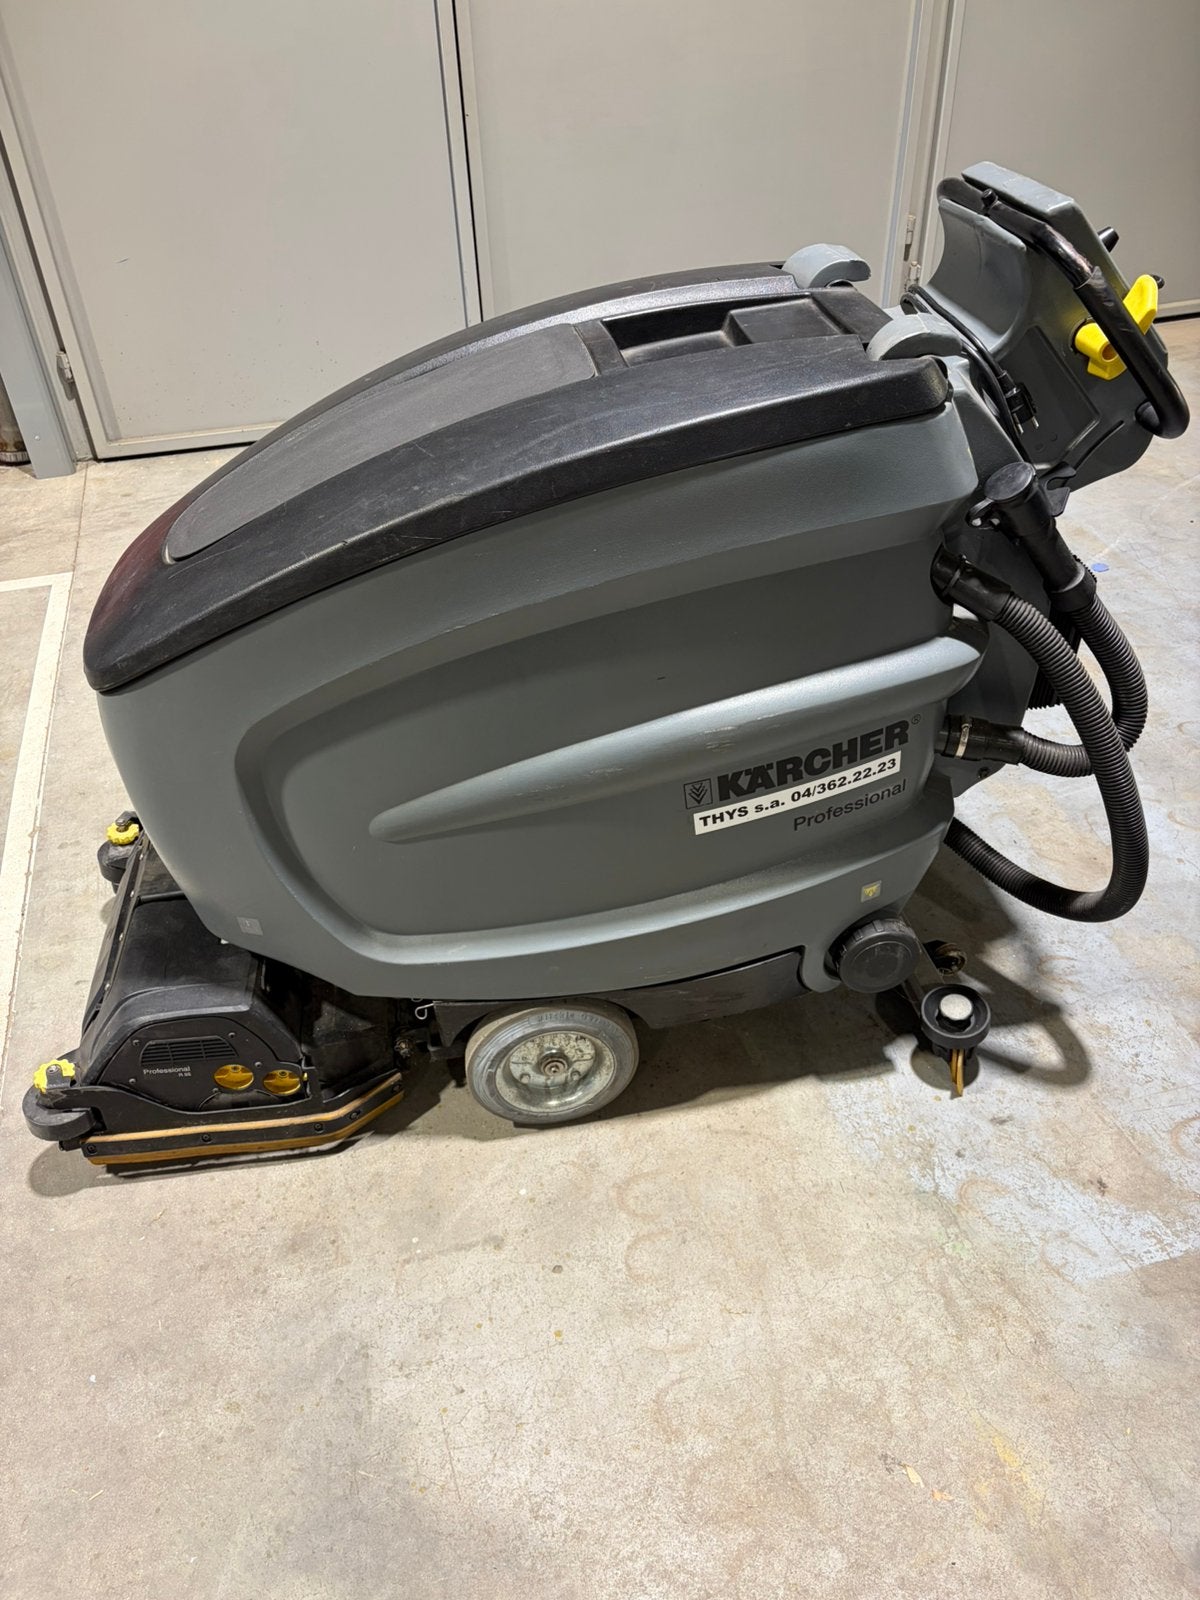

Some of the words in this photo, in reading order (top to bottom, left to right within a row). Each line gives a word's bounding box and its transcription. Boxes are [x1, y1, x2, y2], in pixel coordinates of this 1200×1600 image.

[717, 719, 910, 802] KÄRCHER
[699, 806, 749, 828] THYS
[754, 799, 785, 814] s.a.
[790, 758, 897, 803] 04/362.22.23
[793, 779, 907, 831] Professional
[143, 1066, 191, 1075] Professional
